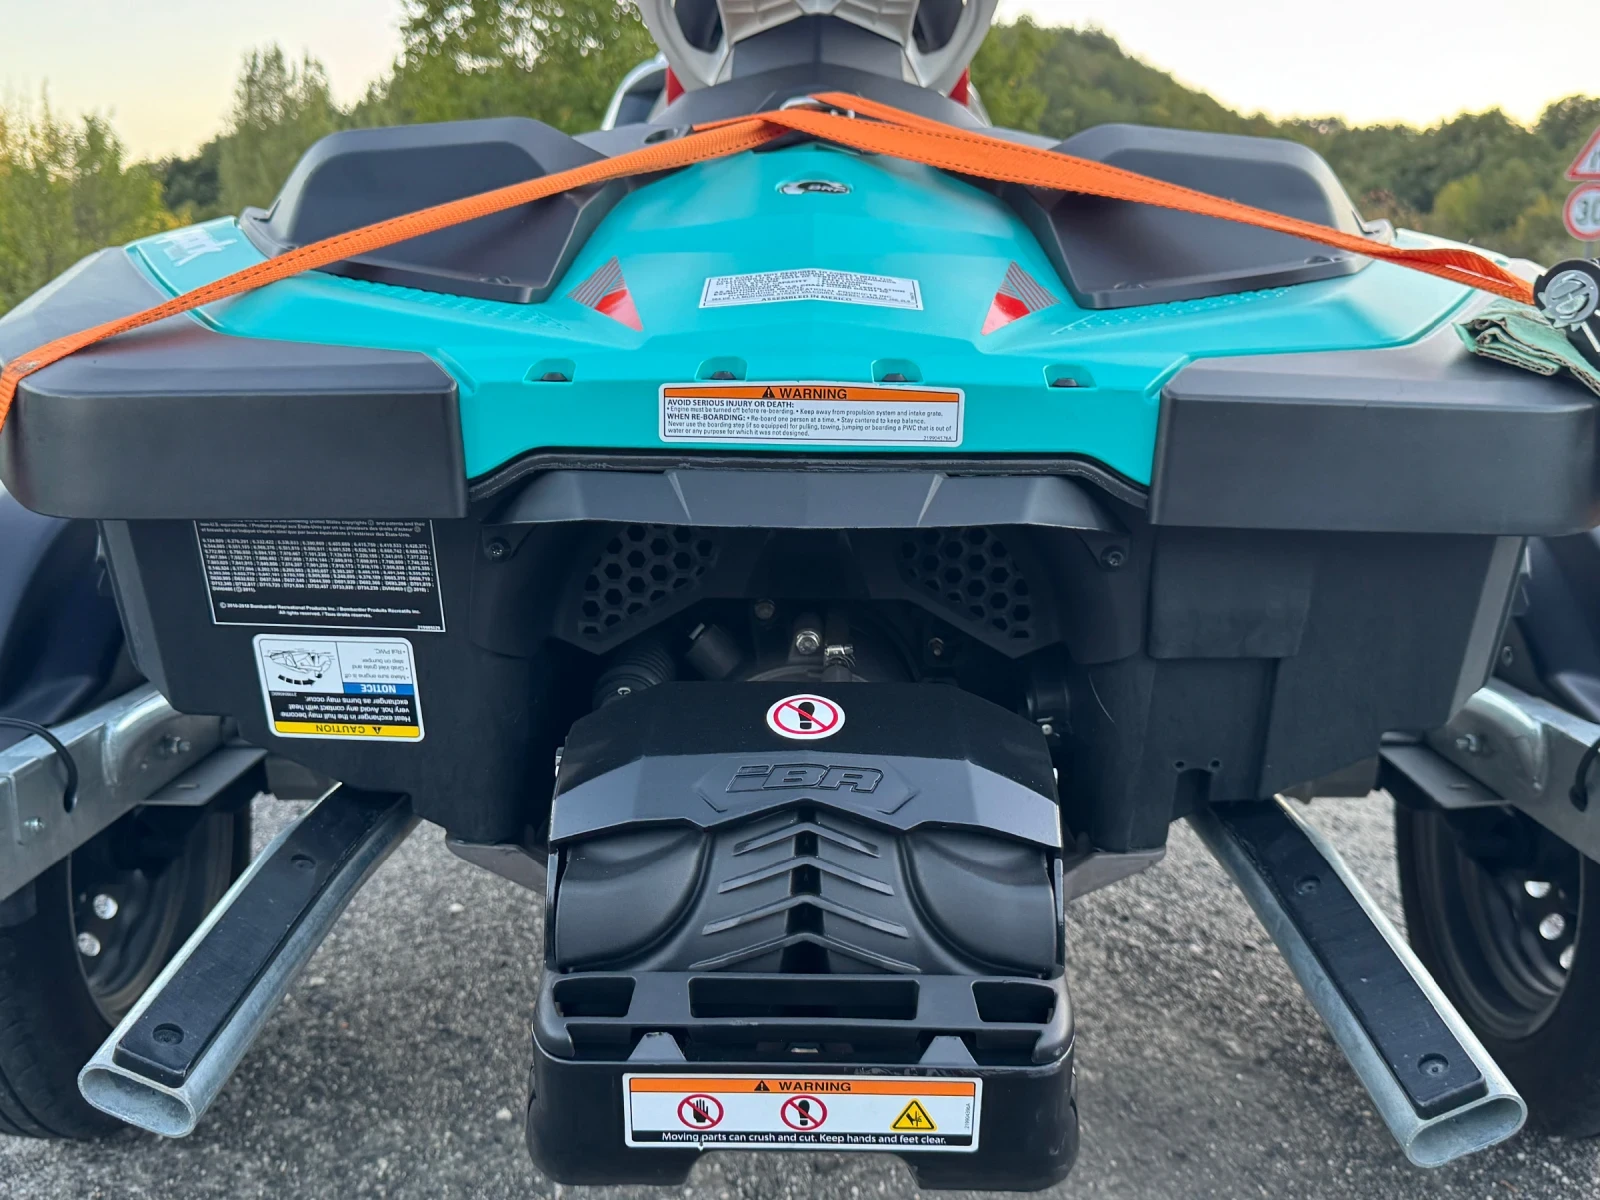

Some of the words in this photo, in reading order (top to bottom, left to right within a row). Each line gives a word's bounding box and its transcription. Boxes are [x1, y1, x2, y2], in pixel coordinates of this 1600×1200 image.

[780, 387, 847, 400] WARNING
[767, 401, 794, 409] DEATH:
[691, 413, 745, 421] RE-BOARDING:
[708, 421, 731, 429] boarding
[360, 683, 397, 694] NOTICE
[304, 695, 325, 703] occur.
[373, 697, 408, 705] exchanger
[320, 704, 344, 712] contact
[346, 704, 359, 712] any
[280, 711, 307, 719] become
[308, 711, 322, 719] may
[357, 713, 393, 722] exchanger
[394, 714, 411, 722] Heat
[315, 724, 366, 734] CAUTION
[778, 1081, 851, 1092] WARNING
[662, 1132, 699, 1143] Moving
[701, 1133, 726, 1143] parts
[728, 1134, 746, 1142] can
[748, 1132, 775, 1142] crush
[777, 1133, 796, 1142] and
[799, 1134, 817, 1143] cut.
[819, 1133, 844, 1144] Keep
[846, 1133, 876, 1143] hands
[878, 1134, 897, 1144] and
[900, 1134, 919, 1144] feet
[921, 1135, 946, 1145] clear.
